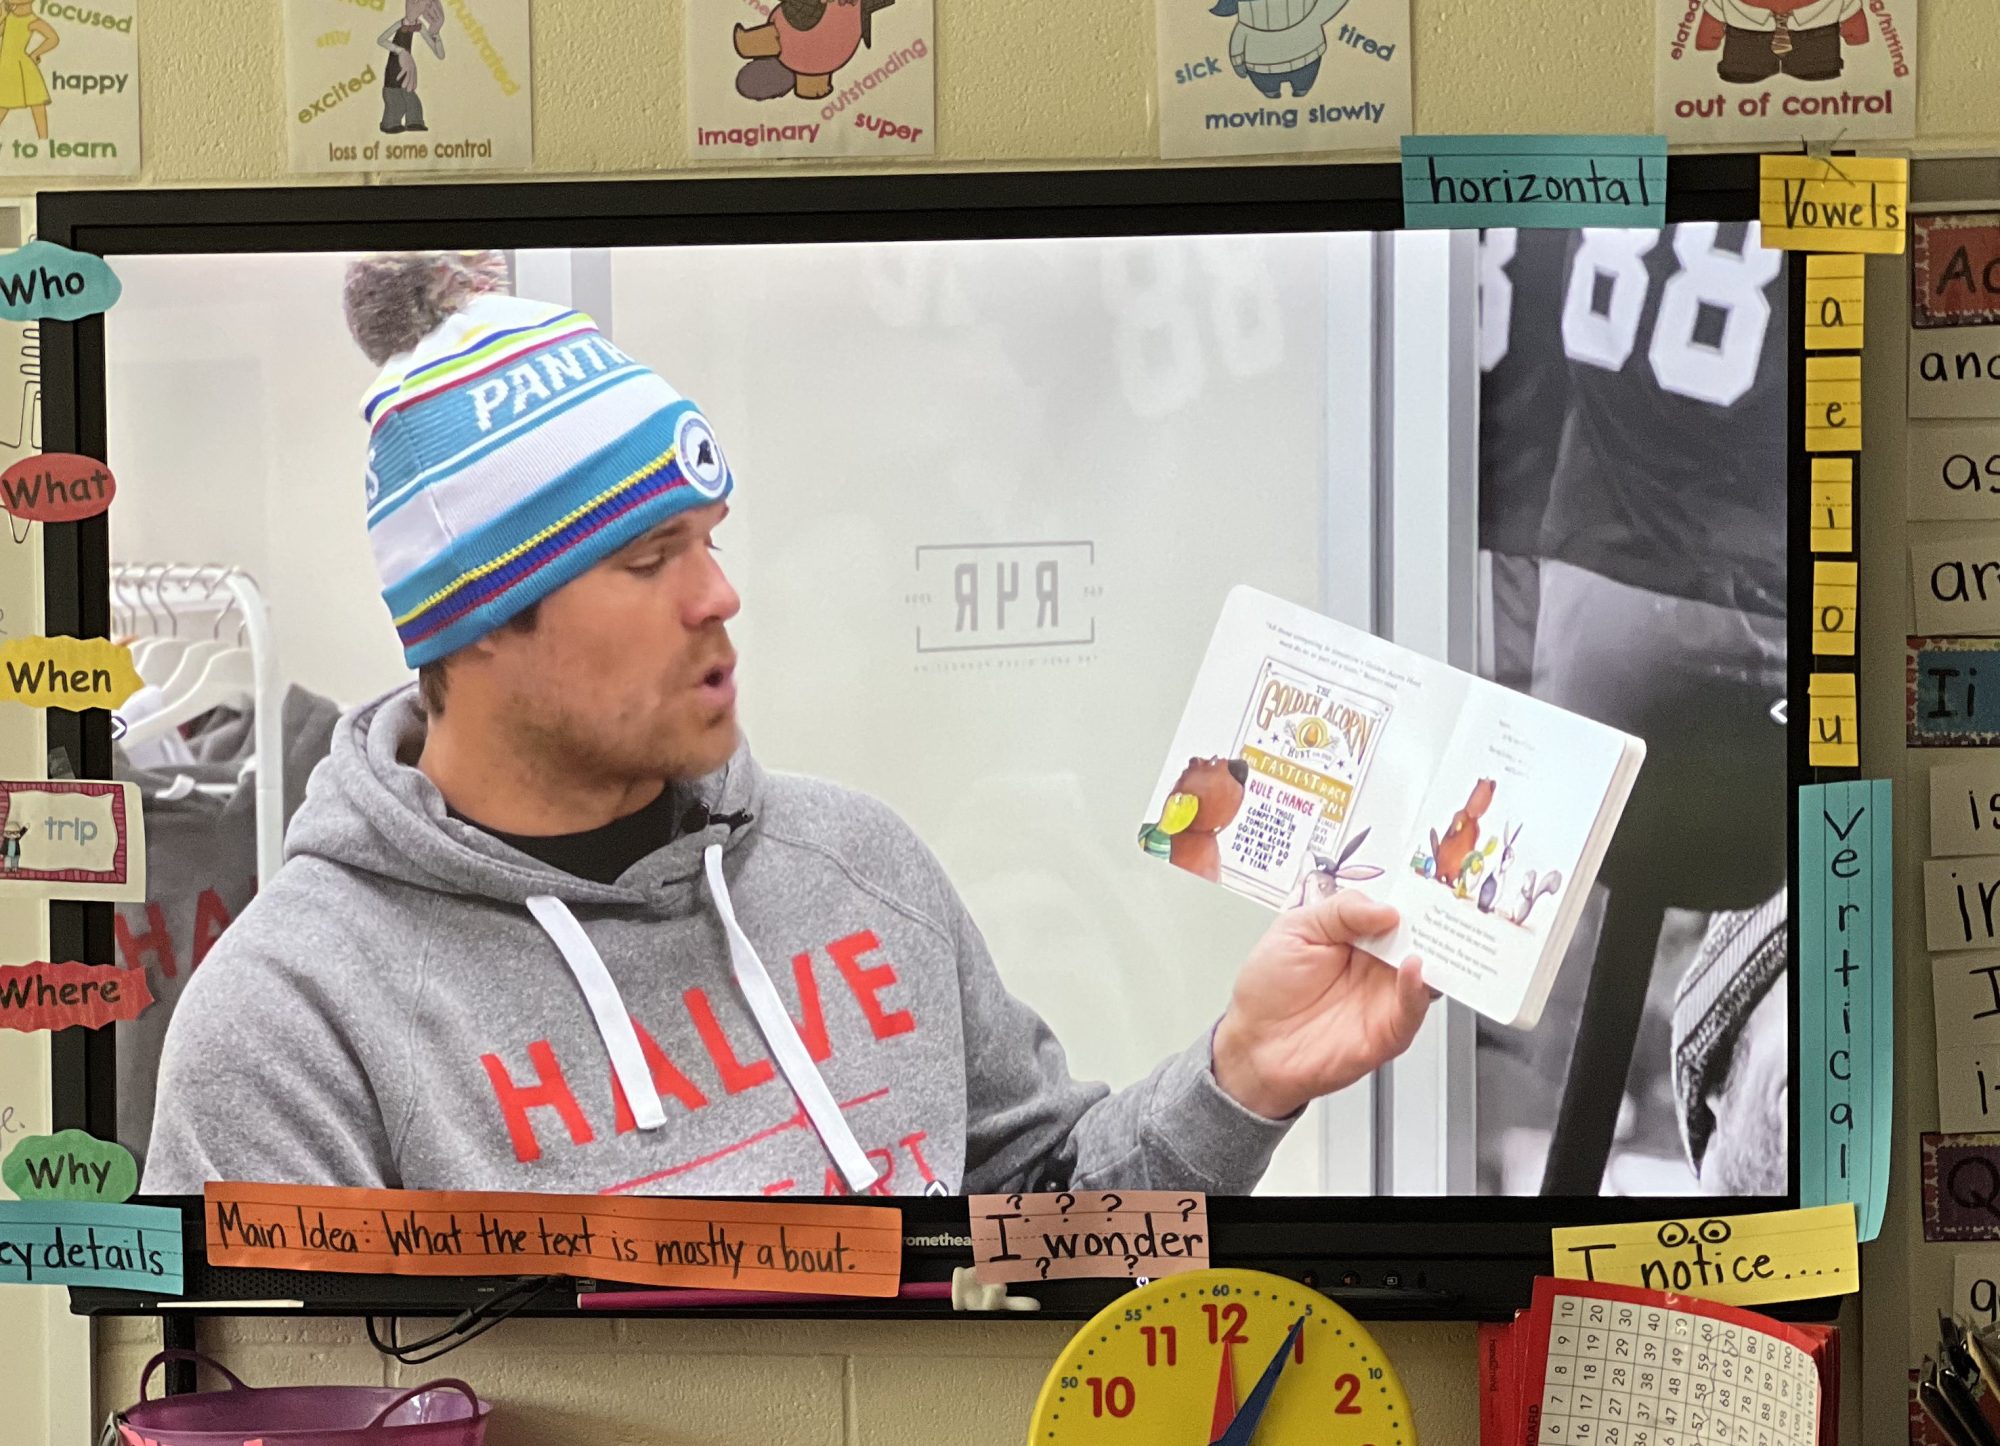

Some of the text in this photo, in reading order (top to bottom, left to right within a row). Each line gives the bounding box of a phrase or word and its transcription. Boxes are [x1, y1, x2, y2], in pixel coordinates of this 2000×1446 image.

[38, 0, 133, 34] focused
[1338, 23, 1396, 62] tired
[820, 37, 928, 121] outstanding
[1174, 56, 1222, 85] sick
[52, 71, 128, 95] happy
[298, 64, 377, 124] excited
[1674, 89, 1892, 118] out of control
[1205, 101, 1386, 130] moving slowly
[698, 123, 820, 147] imaginary
[855, 112, 923, 143] super
[12, 138, 117, 159] to learn
[329, 139, 492, 162] loss of some control
[1428, 155, 1650, 207] horizontal
[1784, 178, 1899, 230] Vowels
[0, 267, 85, 306] Who
[1821, 297, 1844, 327] a
[1825, 401, 1846, 428] e
[2, 470, 109, 504] What
[1826, 496, 1835, 529] i
[1821, 605, 1844, 632] o
[6, 659, 112, 694] When
[1256, 679, 1322, 732] GOLDEN
[1325, 702, 1376, 765] ACORN
[1819, 715, 1842, 744] u
[1259, 755, 1321, 790] FASTEST
[1248, 778, 1273, 799] RULE
[1275, 789, 1315, 816] CHANGE
[44, 815, 98, 846] trip
[0, 974, 121, 1009] Where
[1823, 807, 1866, 1179] Vertical
[25, 1152, 111, 1194] Why
[217, 1201, 287, 1249] Main
[297, 1205, 371, 1252] Idea:
[381, 1210, 462, 1256] What
[477, 1213, 526, 1256] the
[539, 1216, 596, 1257] text
[611, 1231, 639, 1263] is
[656, 1221, 744, 1279] mostly
[986, 1212, 1203, 1262] I wonder
[44, 1227, 163, 1275] details
[1212, 1285, 1229, 1297] 60
[1125, 1309, 1142, 1321] 55
[1305, 1304, 1313, 1316] 5
[1561, 1302, 1574, 1318] 10
[1590, 1305, 1604, 1323] 20
[1619, 1309, 1632, 1327] 30
[1202, 1303, 1249, 1344] 12
[1648, 1314, 1660, 1331] 40
[1558, 1336, 1570, 1344] 9
[1587, 1334, 1600, 1350] 19
[1702, 1324, 1713, 1342] 60
[1725, 1330, 1735, 1349] 70
[1140, 1326, 1177, 1366] 11
[1288, 1324, 1304, 1365] 1
[1616, 1338, 1628, 1356] 29
[1644, 1343, 1656, 1360] 39
[1747, 1336, 1757, 1354] 80
[1767, 1343, 1776, 1360] 90
[1672, 1348, 1684, 1366] 49
[1698, 1354, 1708, 1372] 59
[1784, 1346, 1792, 1369] 100
[1368, 1368, 1383, 1380] 10
[1554, 1366, 1568, 1374] 8
[1584, 1365, 1596, 1380] 18
[1612, 1368, 1626, 1386] 28
[1722, 1360, 1733, 1378] 69
[1744, 1366, 1754, 1384] 79
[1061, 1377, 1078, 1388] 50
[1640, 1373, 1654, 1390] 38
[1668, 1378, 1681, 1396] 48
[1764, 1372, 1772, 1392] 89
[1781, 1380, 1788, 1397] 99
[1086, 1376, 1136, 1418] 10
[1334, 1374, 1362, 1414] 2
[1551, 1396, 1564, 1404] 7
[1695, 1383, 1706, 1400] 58
[1719, 1390, 1730, 1408] 68
[1580, 1394, 1593, 1410] 17
[1608, 1398, 1622, 1416] 27
[1637, 1402, 1650, 1420] 37
[1741, 1396, 1752, 1414] 78
[1665, 1408, 1678, 1425] 47
[1692, 1412, 1704, 1429] 57
[1762, 1403, 1770, 1421] 88
[1779, 1410, 1787, 1428] 98
[1548, 1425, 1560, 1434] 6
[1576, 1424, 1590, 1440] 16
[1605, 1428, 1618, 1445] 26
[1716, 1418, 1727, 1437] 67
[1738, 1425, 1748, 1443] 77
[1634, 1432, 1648, 1446] 36
